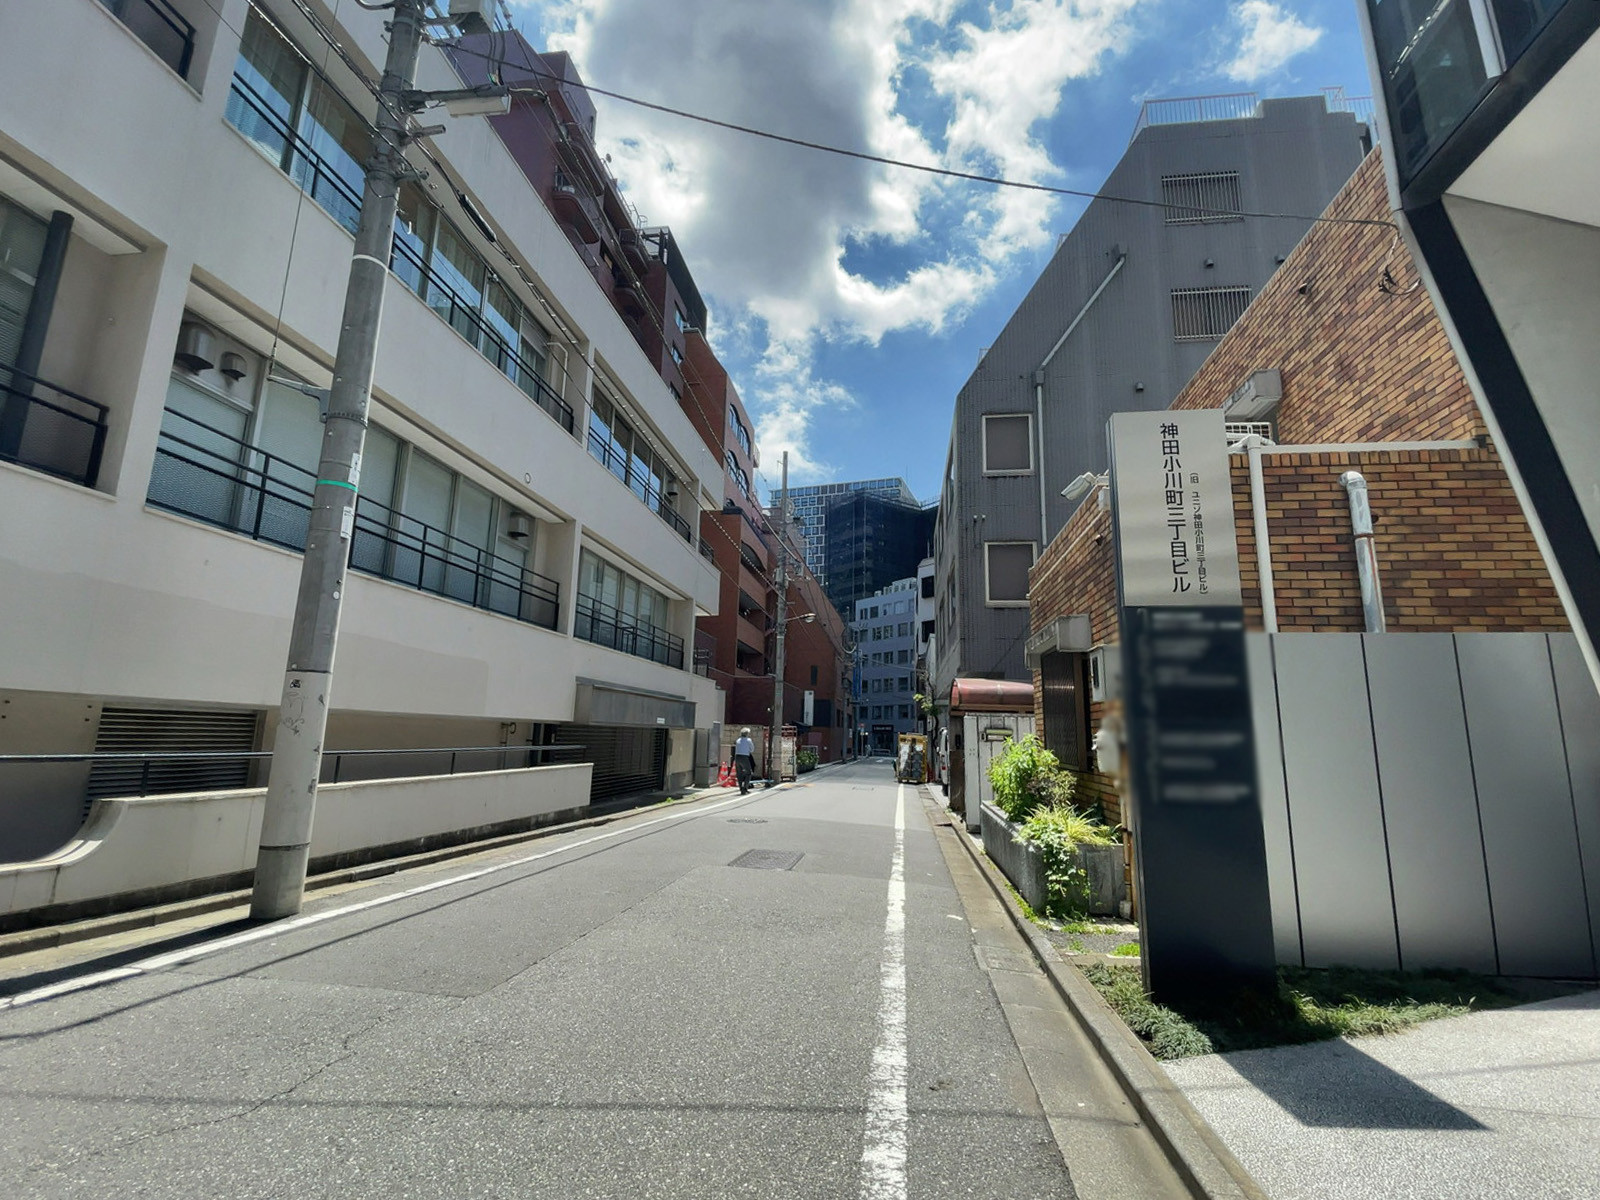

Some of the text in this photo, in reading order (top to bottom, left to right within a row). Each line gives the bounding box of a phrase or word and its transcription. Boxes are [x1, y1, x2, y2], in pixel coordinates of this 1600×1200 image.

[1160, 423, 1191, 592] 神田小川町三丁目ビル
